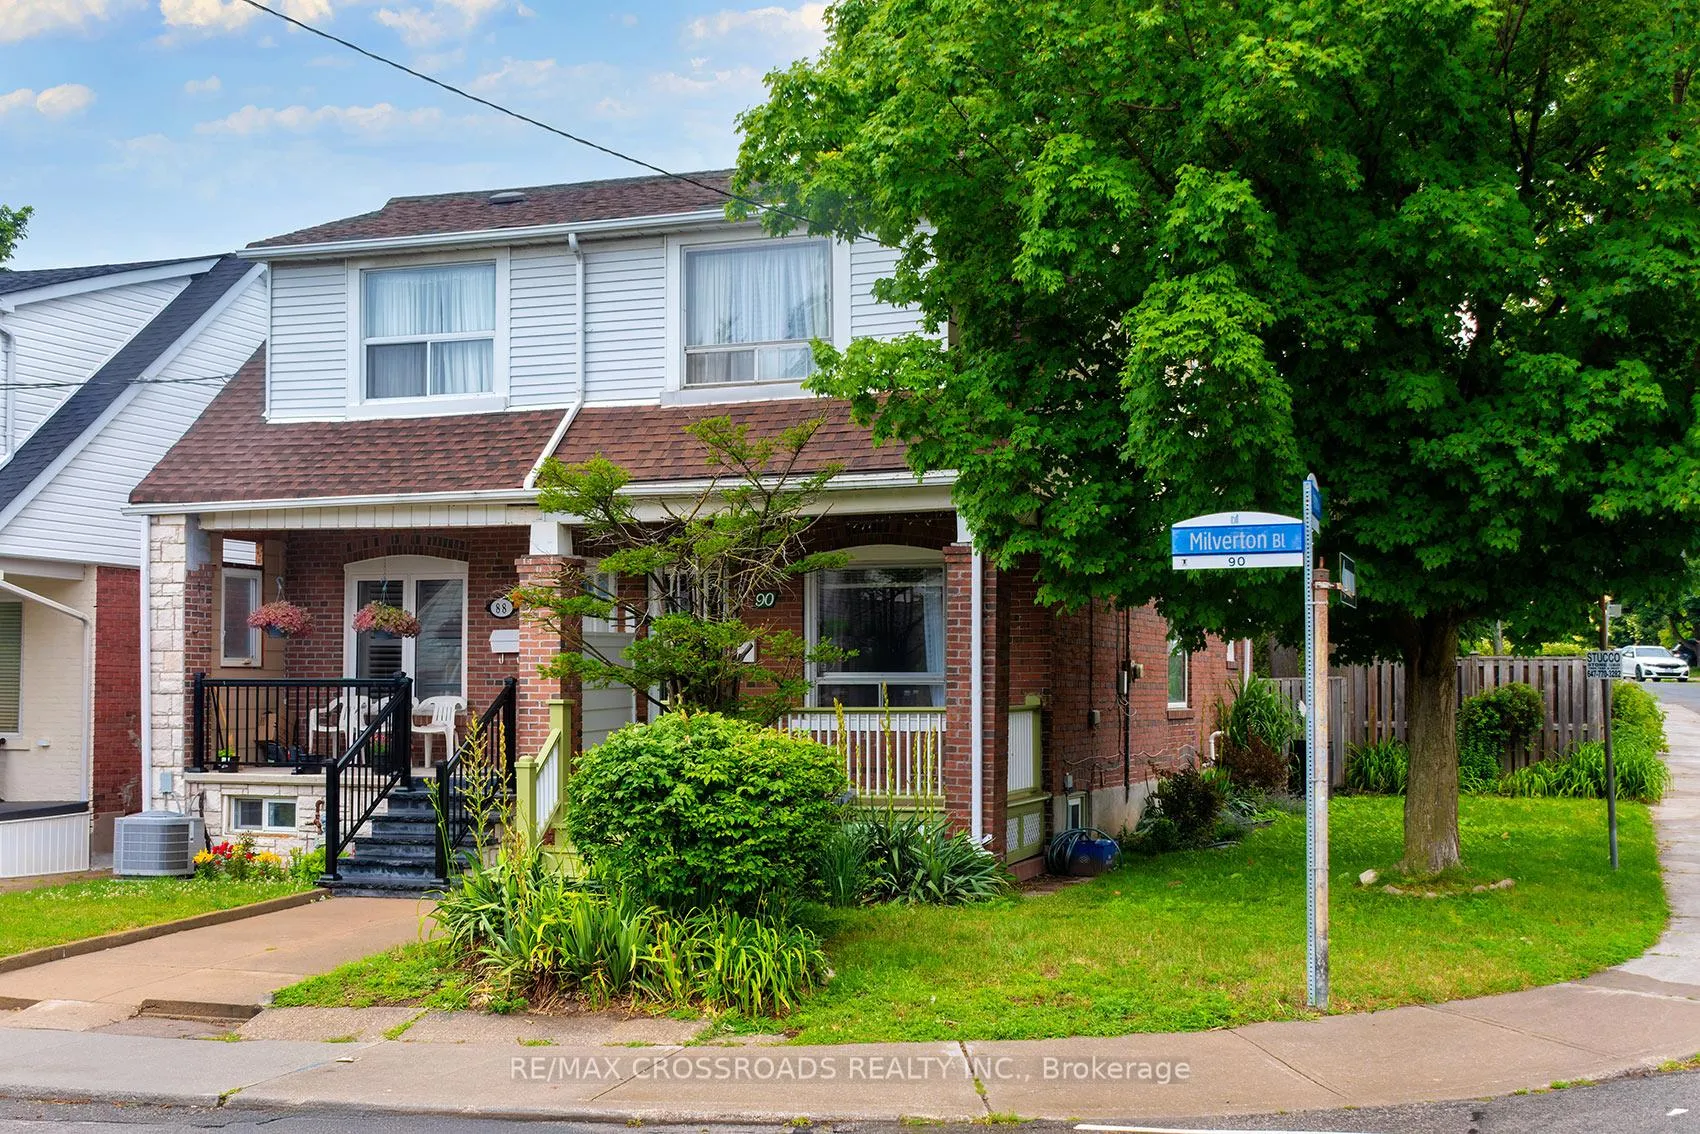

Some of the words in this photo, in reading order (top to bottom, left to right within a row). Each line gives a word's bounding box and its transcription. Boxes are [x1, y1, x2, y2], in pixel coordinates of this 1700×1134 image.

[1190, 532, 1267, 551] Milverton
[1272, 533, 1286, 548] Bl
[1228, 556, 1245, 567] 90
[755, 593, 774, 608] 90
[495, 602, 507, 614] 88
[1587, 652, 1620, 662] STUCCO
